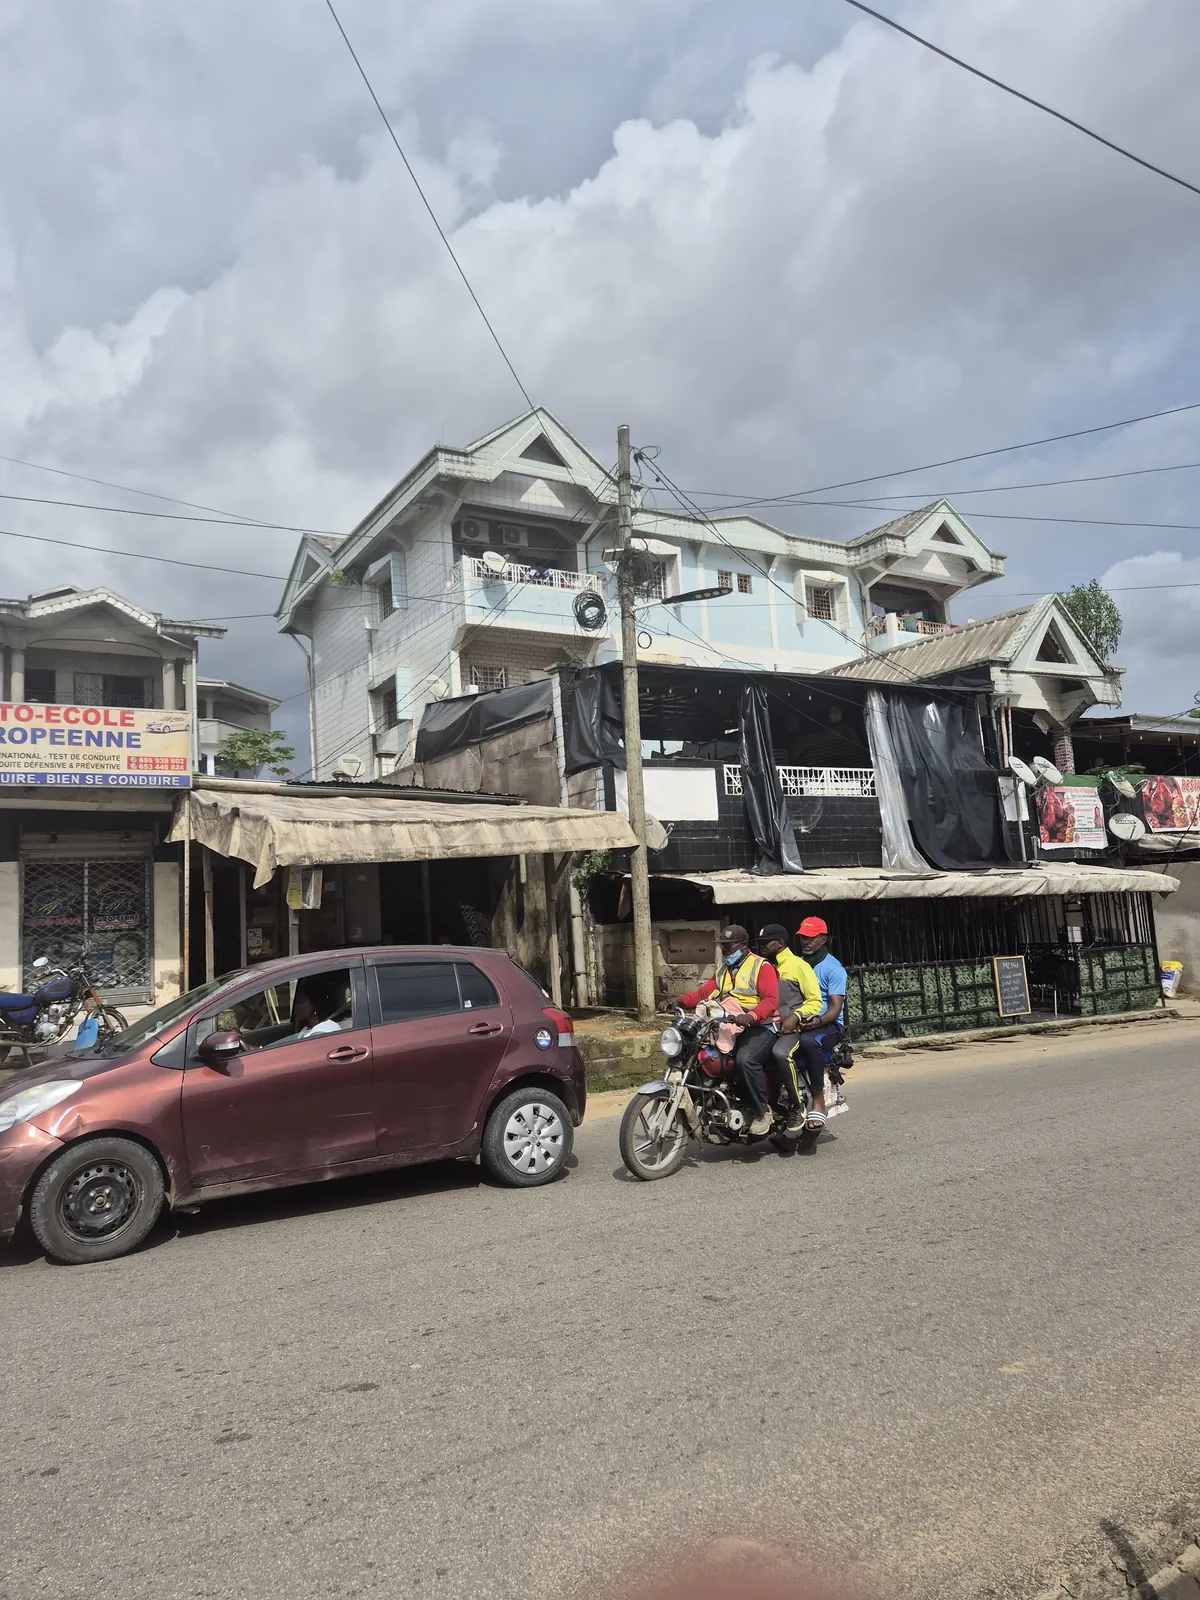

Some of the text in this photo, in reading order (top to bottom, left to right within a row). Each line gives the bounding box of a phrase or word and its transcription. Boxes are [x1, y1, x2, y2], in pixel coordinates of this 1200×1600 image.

[0, 704, 135, 727] TO-ECOLE
[0, 752, 41, 760] NATIONAL
[24, 760, 67, 769] DÉFENSIVE
[75, 761, 120, 770] PRÉVENTIVE
[46, 774, 80, 784] BIEN
[85, 775, 103, 785] SE
[108, 775, 180, 785] CONDUIRE
